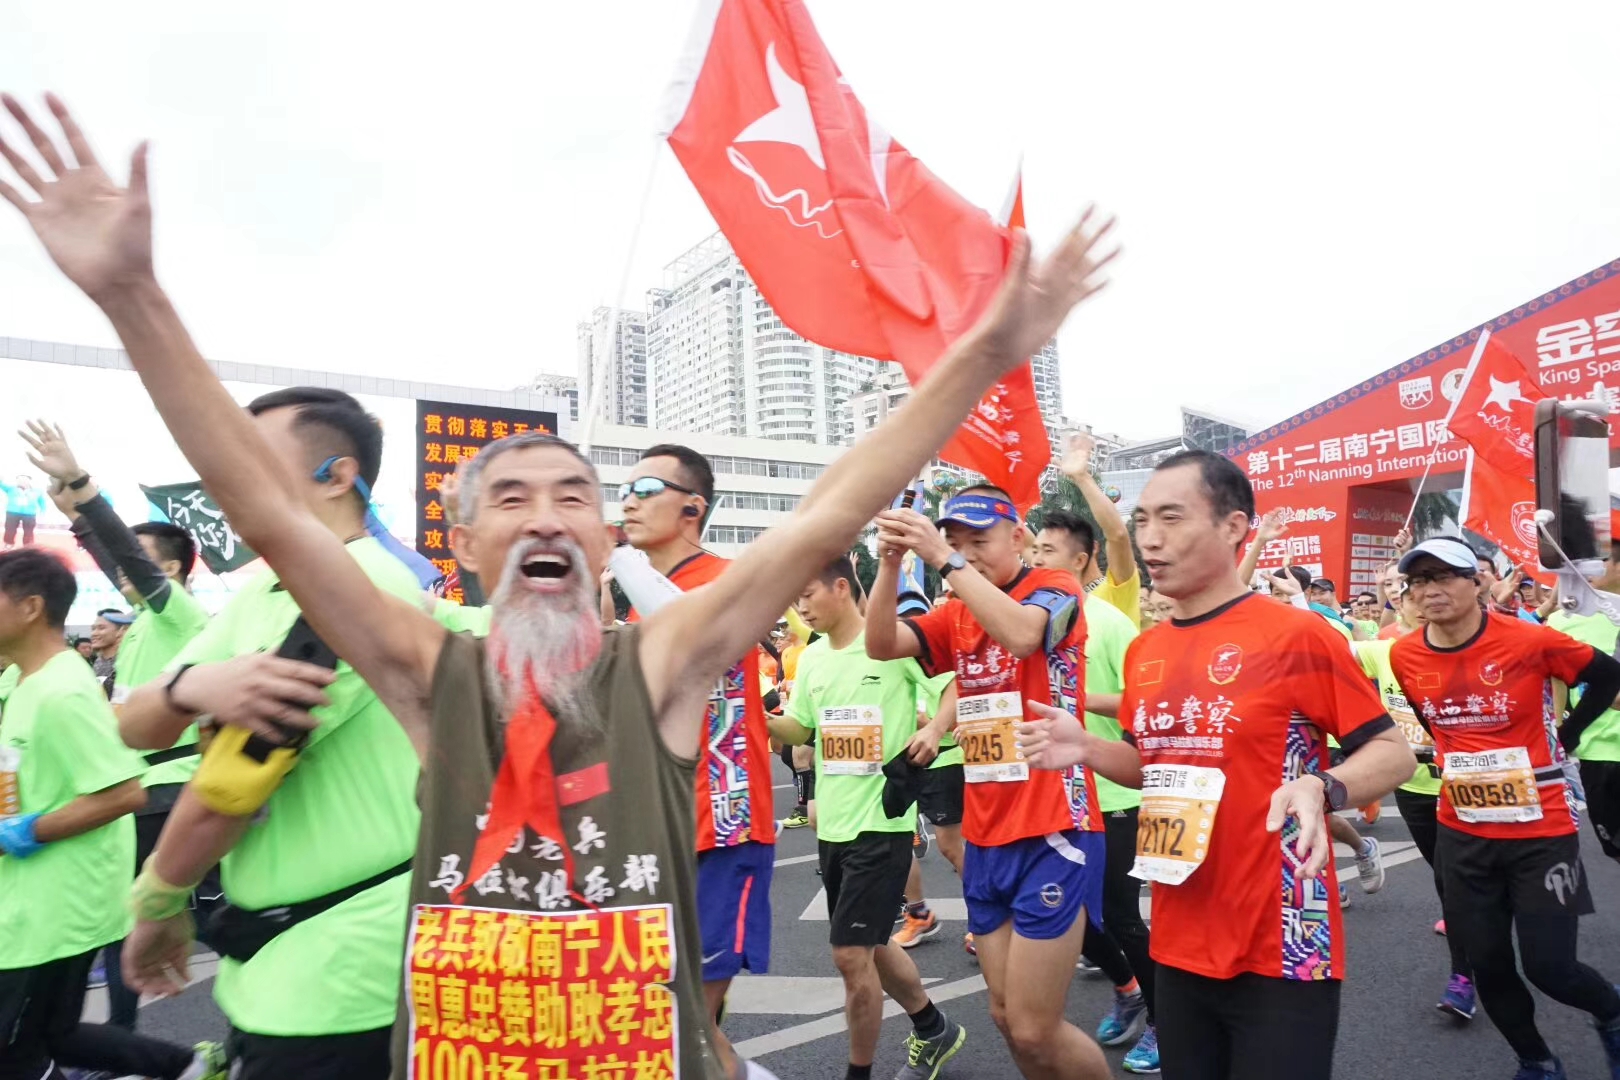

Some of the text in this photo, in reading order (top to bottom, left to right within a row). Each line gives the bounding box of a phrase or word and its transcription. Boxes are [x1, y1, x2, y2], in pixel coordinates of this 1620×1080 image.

[1539, 368, 1581, 385] King
[1247, 418, 1455, 475] 第十二届南宁国际
[1250, 479, 1273, 492] The
[1278, 468, 1306, 488] 12th
[1309, 463, 1372, 483] Nanning
[1448, 782, 1518, 808] 10958
[412, 907, 671, 978] 老兵致敬南宁人民
